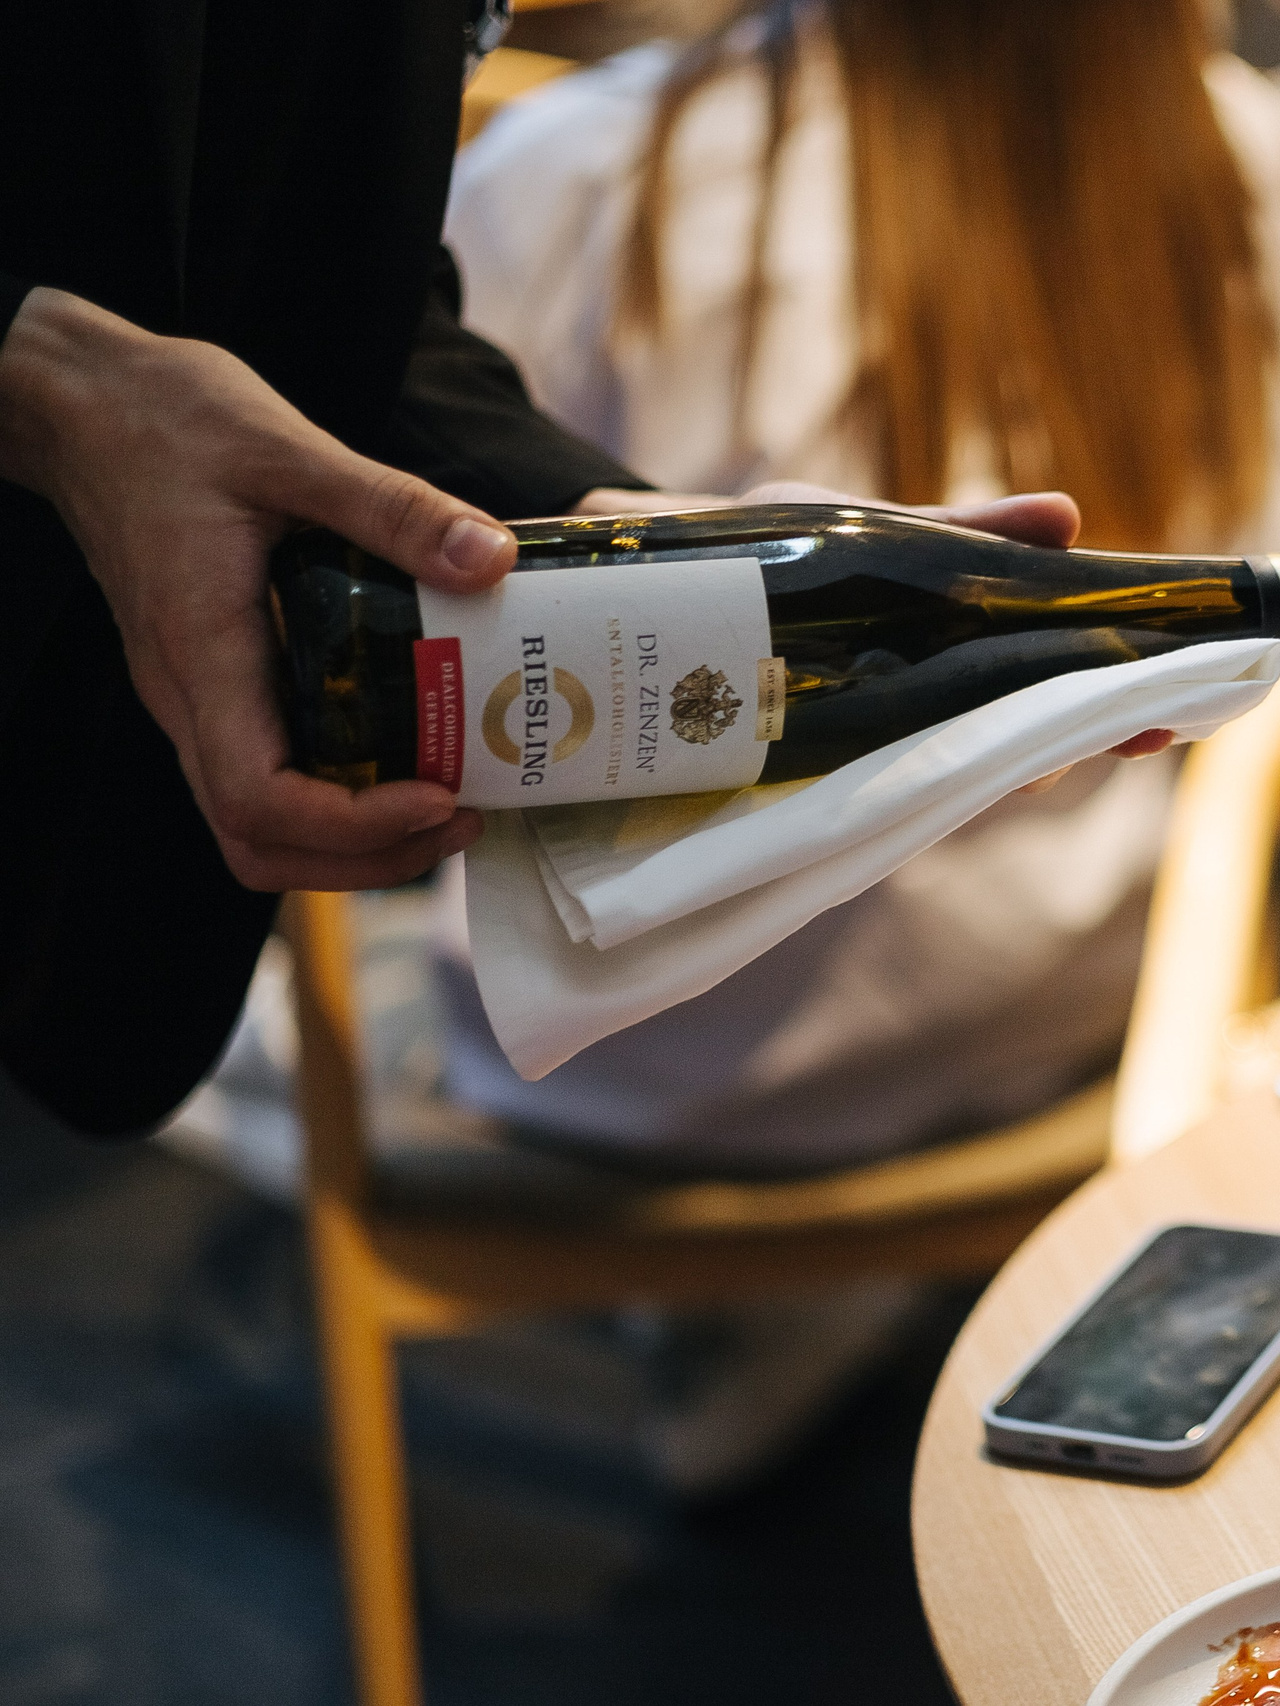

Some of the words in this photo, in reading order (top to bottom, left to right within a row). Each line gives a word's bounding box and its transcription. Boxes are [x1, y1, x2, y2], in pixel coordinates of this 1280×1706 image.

[636, 633, 660, 678] DR.
[425, 690, 439, 764] GERMANY
[441, 661, 458, 783] DEALCOHOLIZED
[520, 634, 548, 788] RIESLING
[766, 689, 775, 713] SINCE
